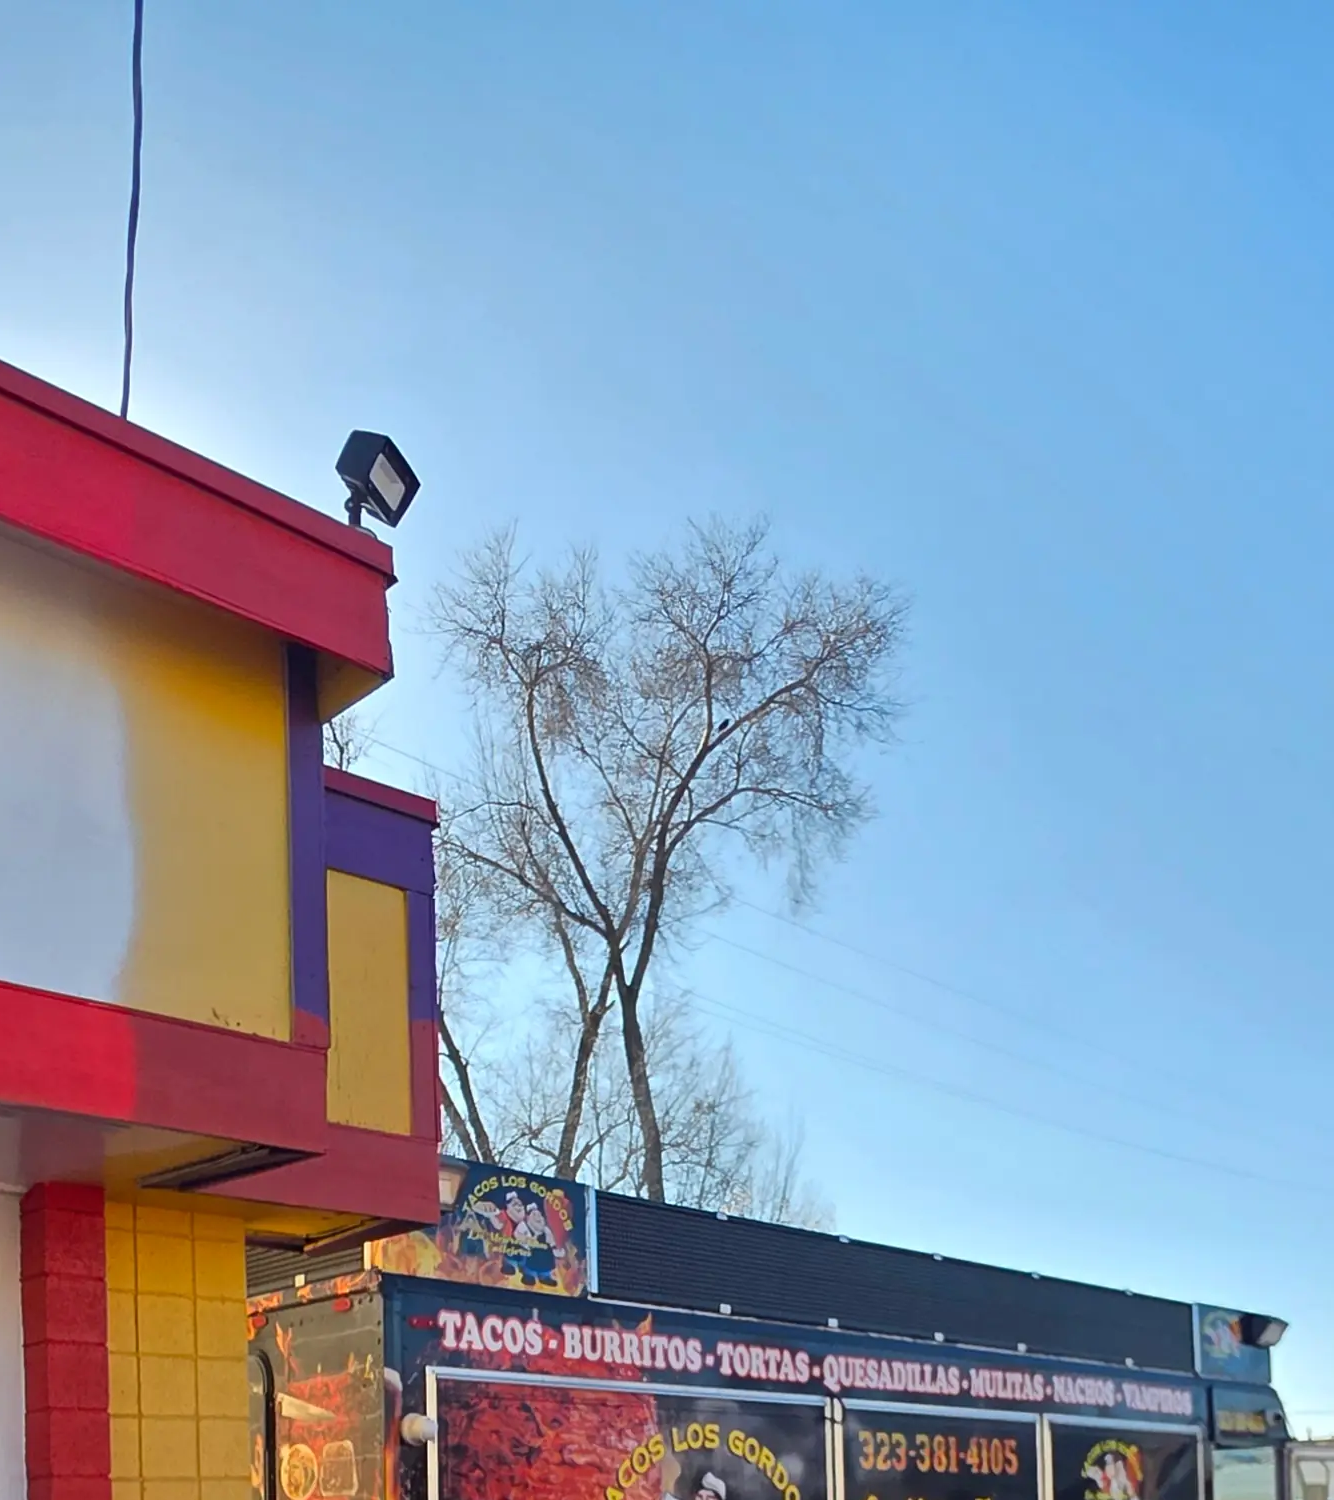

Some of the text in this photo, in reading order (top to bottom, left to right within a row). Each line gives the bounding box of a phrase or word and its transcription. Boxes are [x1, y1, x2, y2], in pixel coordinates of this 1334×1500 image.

[461, 1177, 499, 1213] TACOS
[501, 1175, 527, 1189] LOS
[438, 1310, 1192, 1416] TACOS BURRITOS TORTAS QUESADILLAS MULITAS NACHOS VAMPIROS
[671, 1422, 720, 1453] LOS
[857, 1430, 1019, 1475] 323-381-4105
